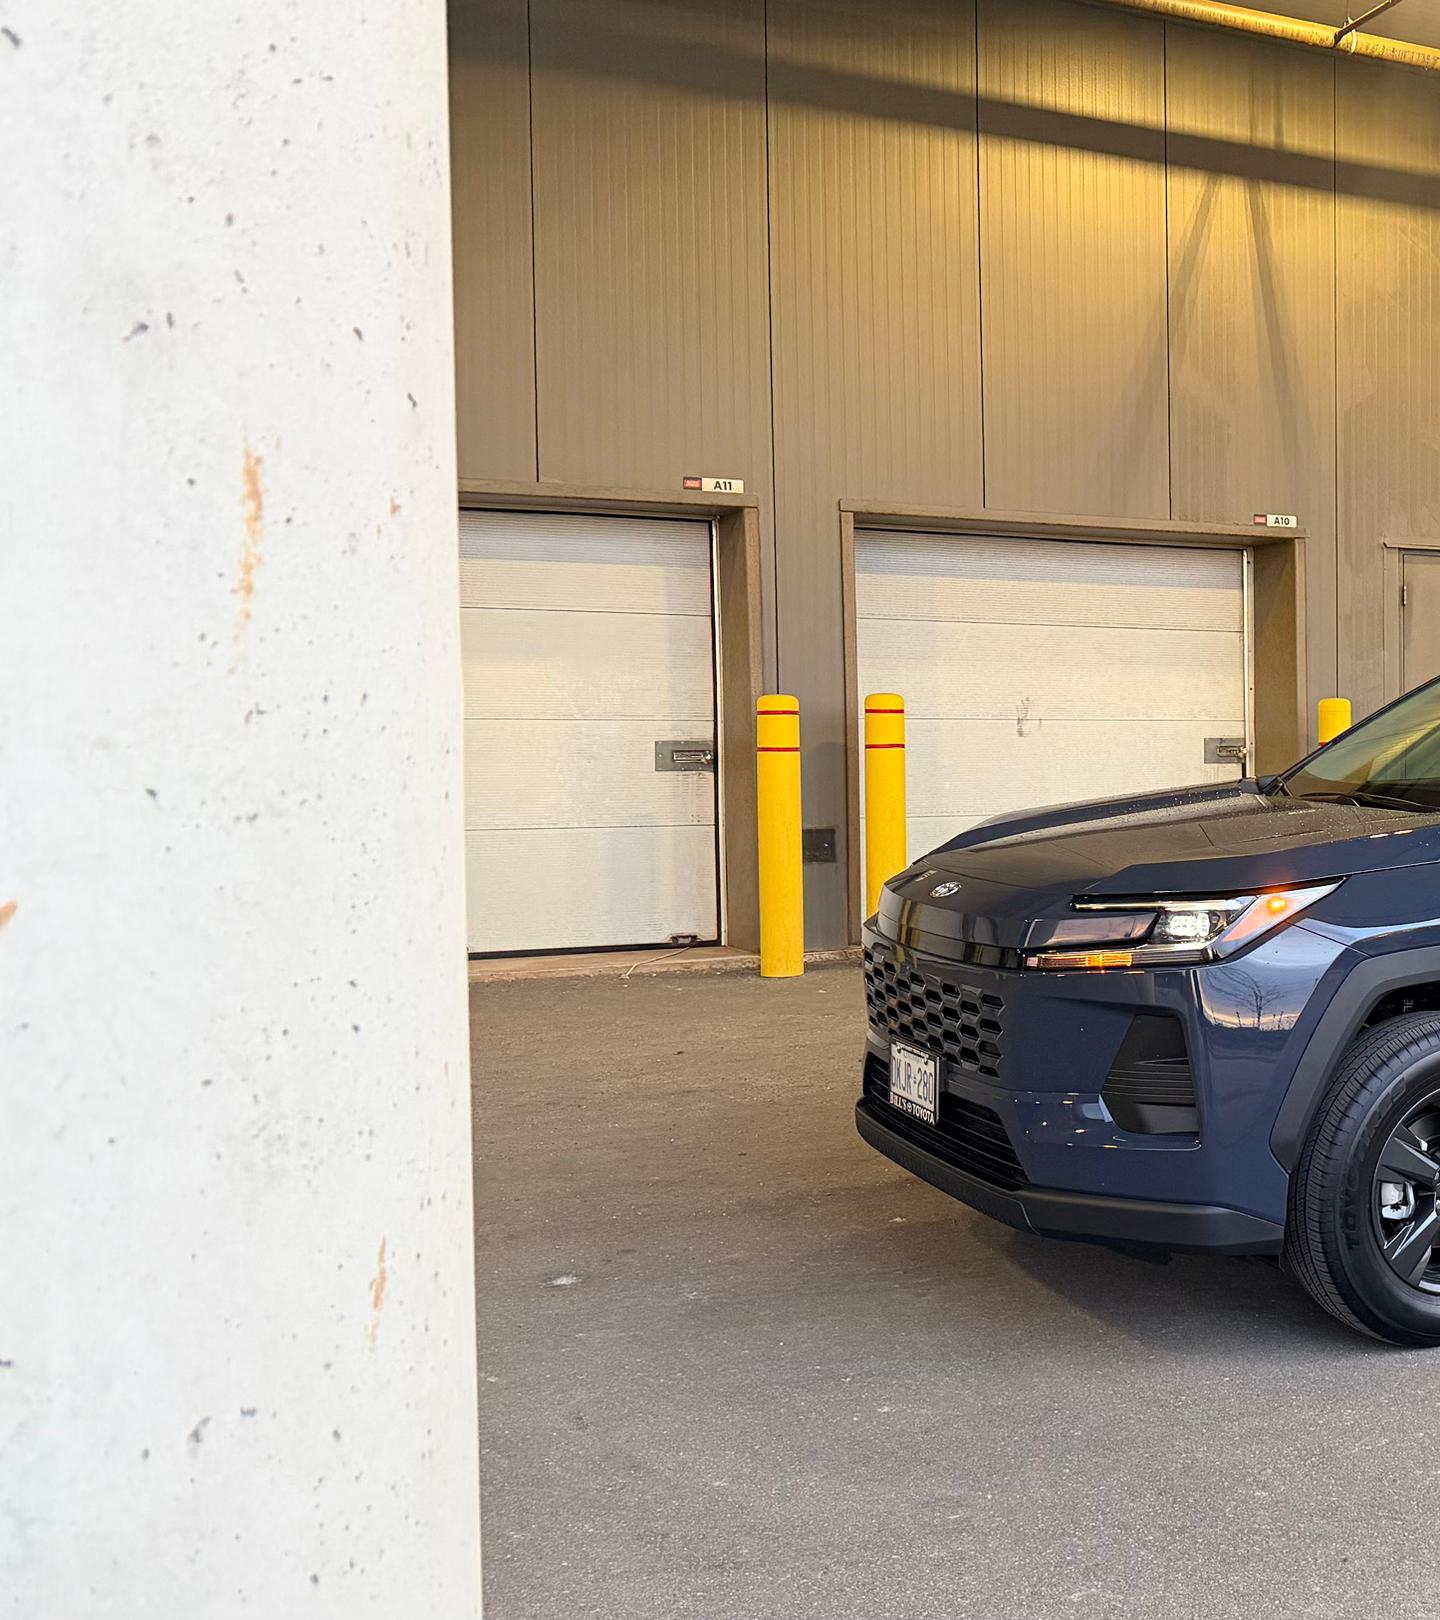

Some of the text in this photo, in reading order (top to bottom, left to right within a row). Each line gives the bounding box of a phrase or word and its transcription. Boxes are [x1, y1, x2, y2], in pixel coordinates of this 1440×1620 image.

[713, 481, 733, 491] A11
[1274, 516, 1290, 526] A10
[911, 1102, 935, 1126] TOYOTA
